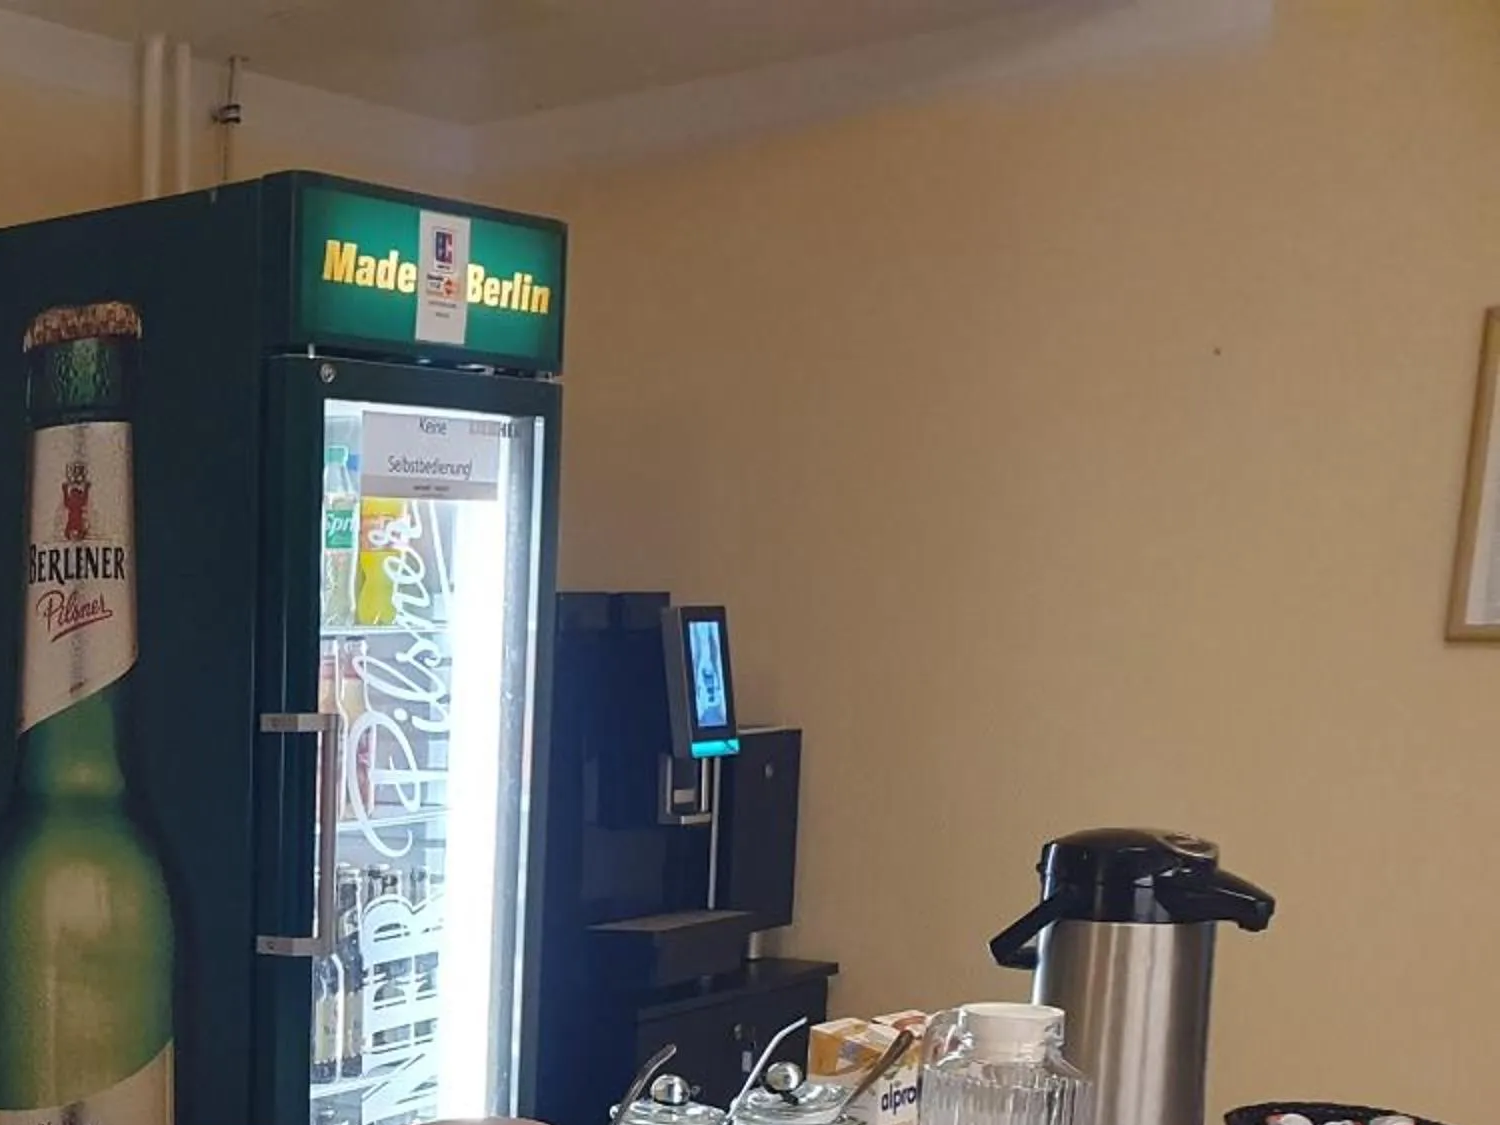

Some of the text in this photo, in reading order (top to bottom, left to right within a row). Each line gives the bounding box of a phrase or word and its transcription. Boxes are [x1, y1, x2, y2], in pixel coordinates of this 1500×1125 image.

[322, 239, 551, 315] Made Berlin
[29, 544, 125, 585] BERLINER
[36, 589, 113, 640] Pilsner
[881, 1083, 917, 1116] alpro
